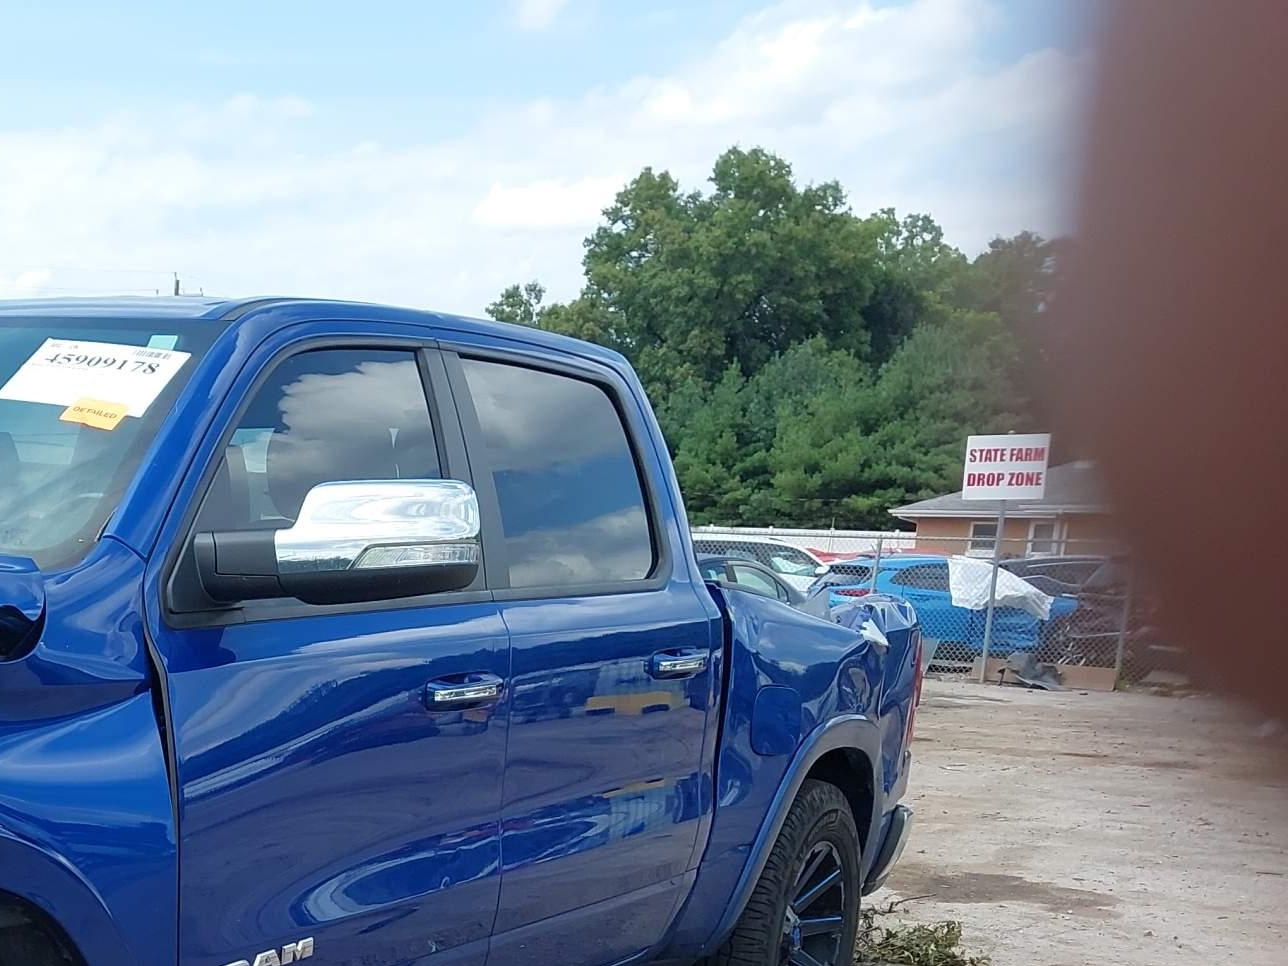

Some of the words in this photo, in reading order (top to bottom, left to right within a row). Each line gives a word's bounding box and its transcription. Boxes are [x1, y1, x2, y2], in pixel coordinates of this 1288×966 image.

[45, 352, 160, 375] 45909178
[969, 447, 1007, 463] STATE
[1009, 447, 1045, 462] FARM
[967, 472, 1005, 487] DROP
[1007, 471, 1043, 486] ZONE
